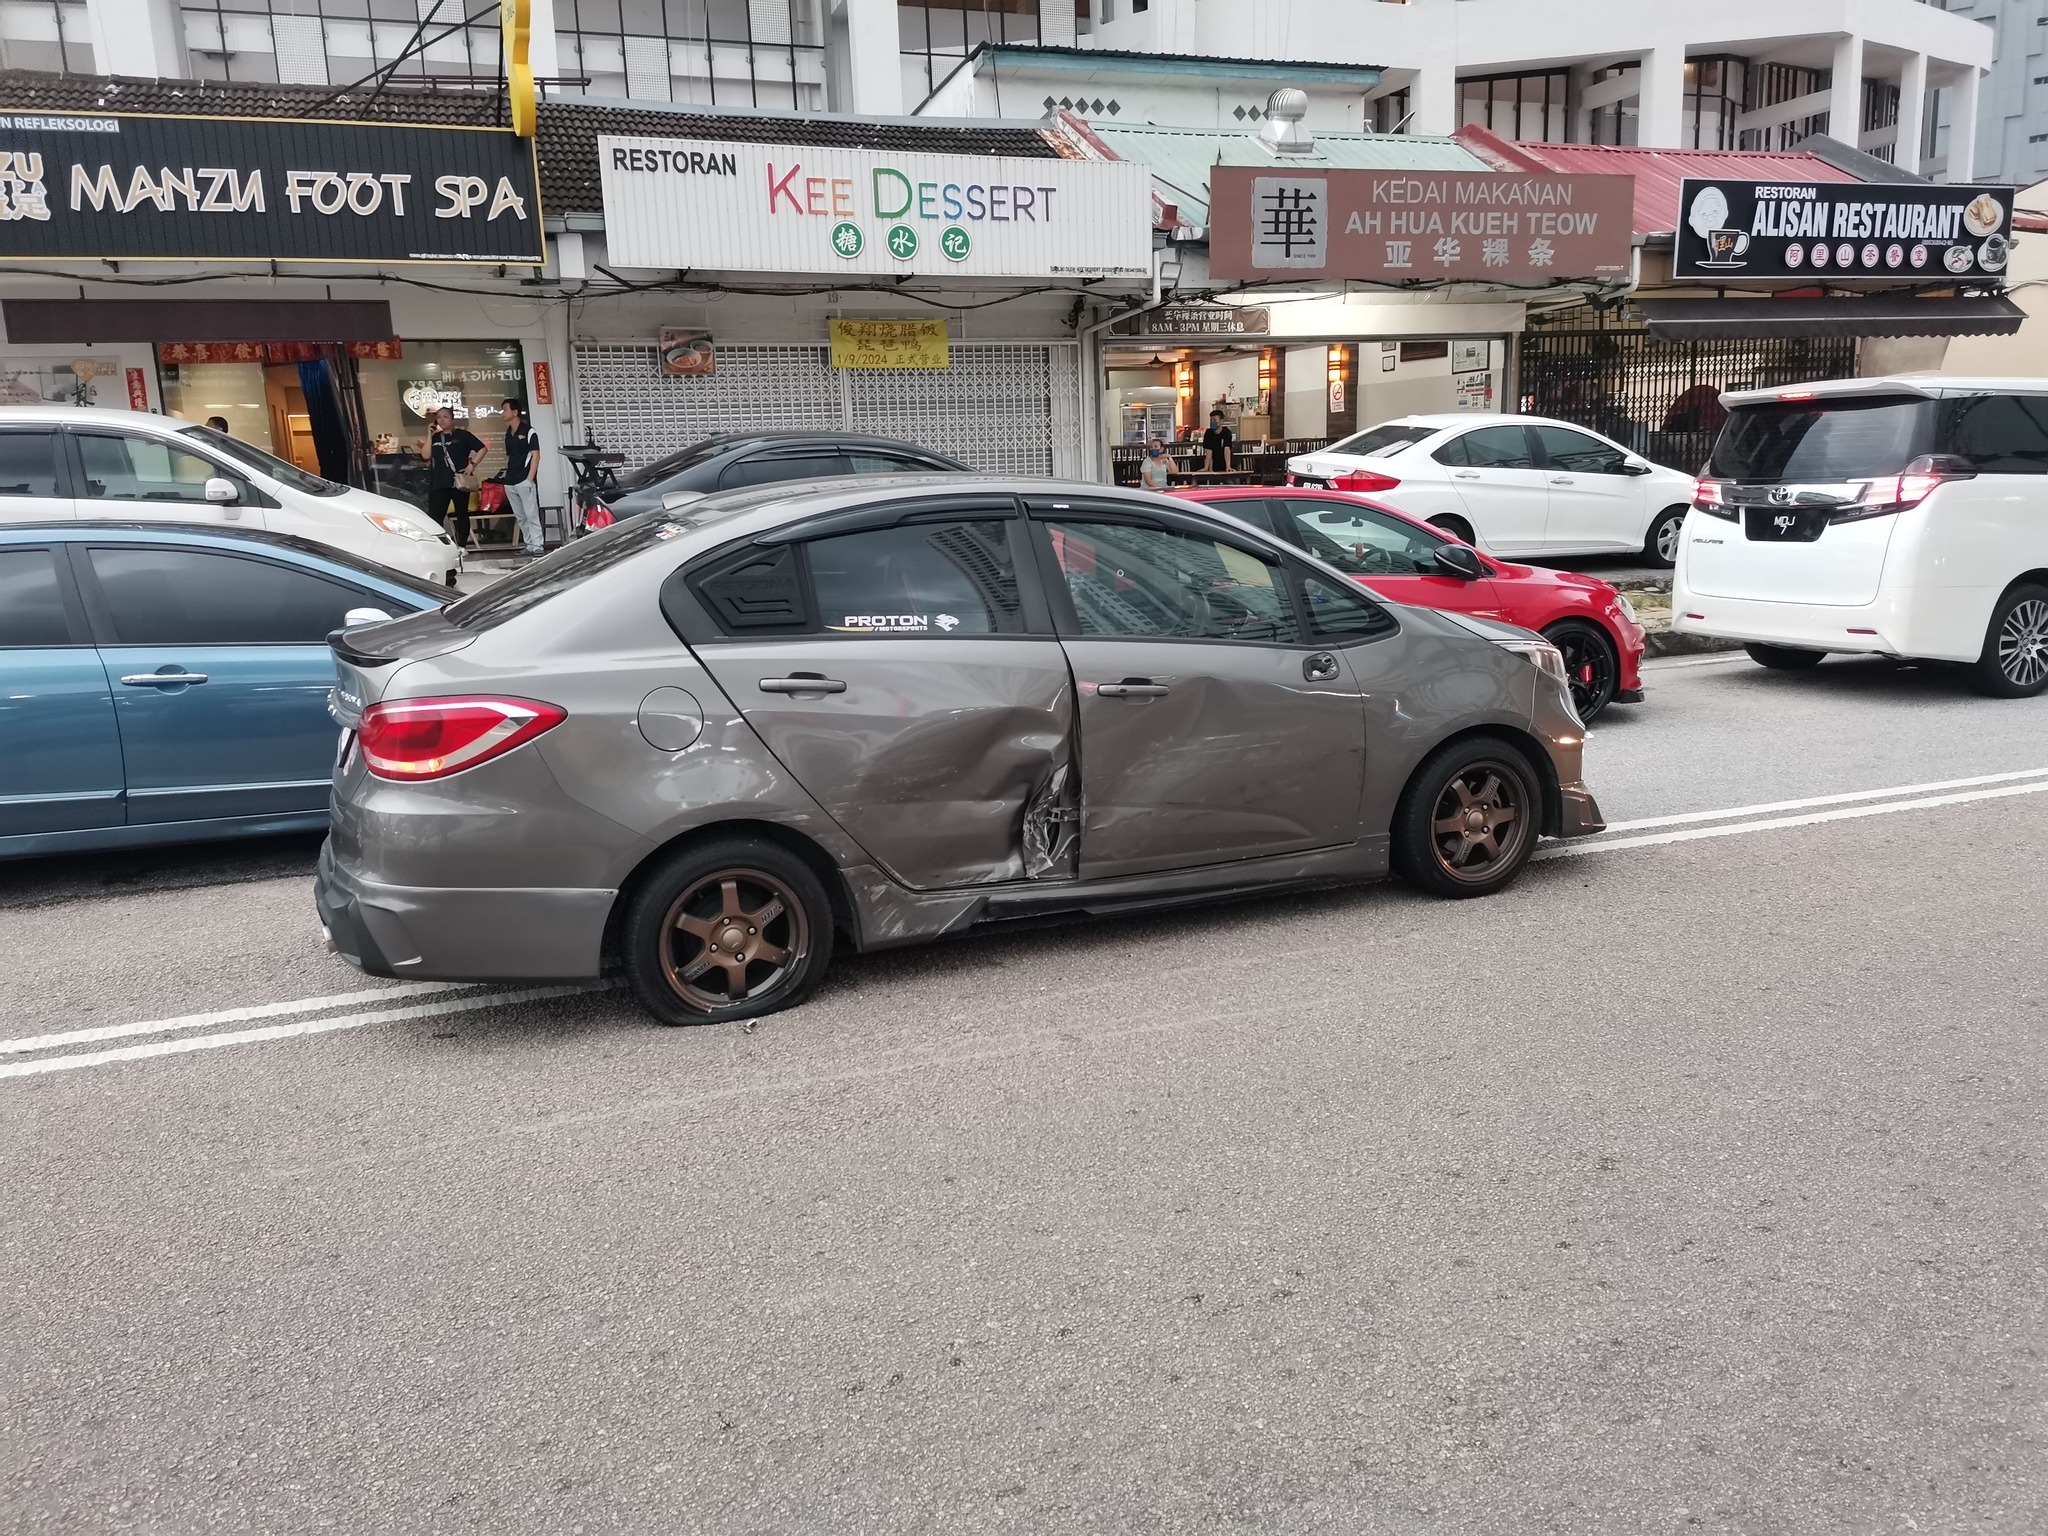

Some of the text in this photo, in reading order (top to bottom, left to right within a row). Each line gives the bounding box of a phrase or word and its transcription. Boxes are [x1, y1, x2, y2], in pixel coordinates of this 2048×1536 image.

[14, 117, 120, 132] REFLEKSOLOGI
[612, 147, 737, 176] RESTORAN
[71, 164, 527, 221] MANZU FOOT SPA
[767, 162, 1057, 222] KEE DESSERT
[1372, 178, 1572, 206] KEDAI MAKANAN
[1754, 186, 1817, 200] RESTORAN
[1260, 187, 1318, 258] 華
[1344, 211, 1598, 236] AH HUA KUEH TEOW
[1751, 200, 1965, 239] ALISAN RESTAURANT
[834, 224, 967, 256] 糖水记
[1383, 237, 1555, 268] 亚华粿条
[837, 321, 939, 338] 俊翔烧腊饭
[1151, 322, 1173, 332] 8AM
[1180, 322, 1200, 332] 3PM
[1202, 321, 1245, 332] 星期三休息
[857, 338, 922, 351] 琵琶鸭
[837, 354, 942, 365] 1/9/2024 正式营业
[1780, 526, 1788, 535] 7
[844, 615, 928, 627] PROTON
